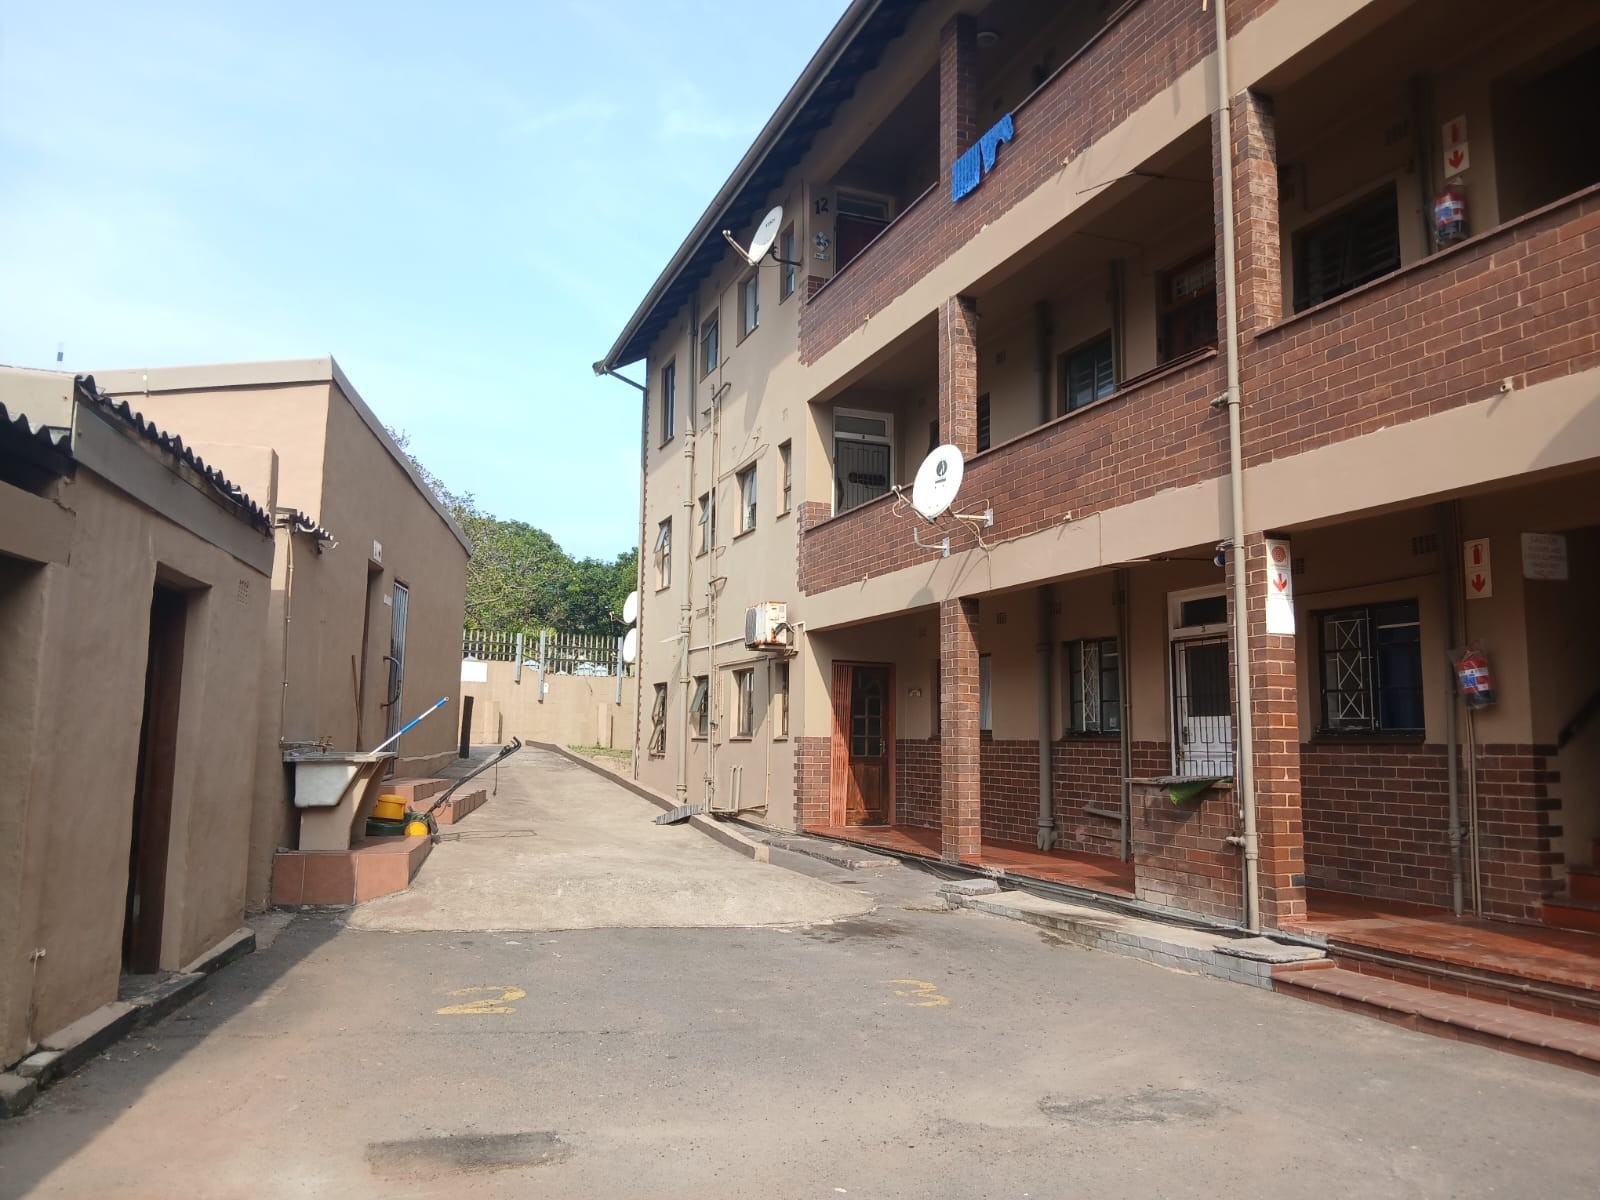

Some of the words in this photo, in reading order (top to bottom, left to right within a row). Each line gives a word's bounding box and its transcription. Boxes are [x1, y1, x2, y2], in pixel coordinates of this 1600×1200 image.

[815, 197, 829, 215] 12
[433, 985, 526, 1015] 2
[879, 979, 952, 1007] 3
